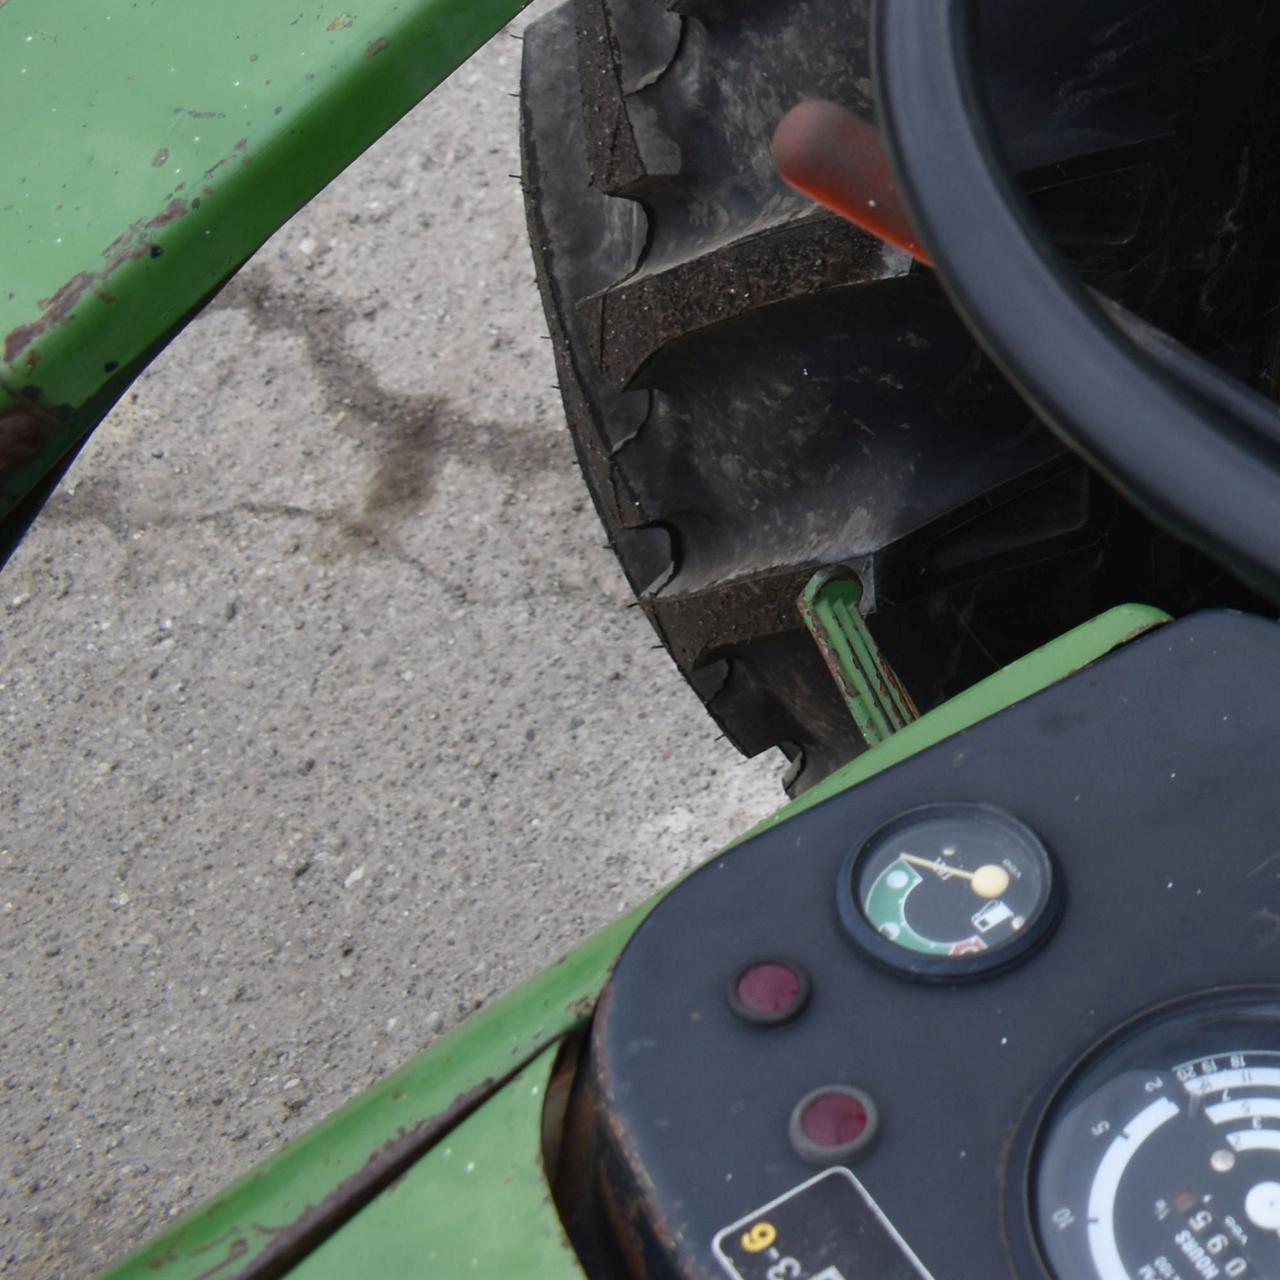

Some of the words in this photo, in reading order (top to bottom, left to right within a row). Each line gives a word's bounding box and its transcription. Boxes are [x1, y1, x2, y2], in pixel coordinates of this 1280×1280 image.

[1176, 1065, 1196, 1082] 20
[1201, 1059, 1217, 1073] 19
[1230, 1055, 1245, 1069] 18
[1241, 1070, 1252, 1082] 11
[1145, 1076, 1163, 1092] 2
[1222, 1088, 1230, 1102] 7
[1092, 1120, 1110, 1136] 5
[1252, 1115, 1261, 1129] 3
[1052, 1208, 1075, 1230] 10
[1174, 1230, 1220, 1280] HOURS
